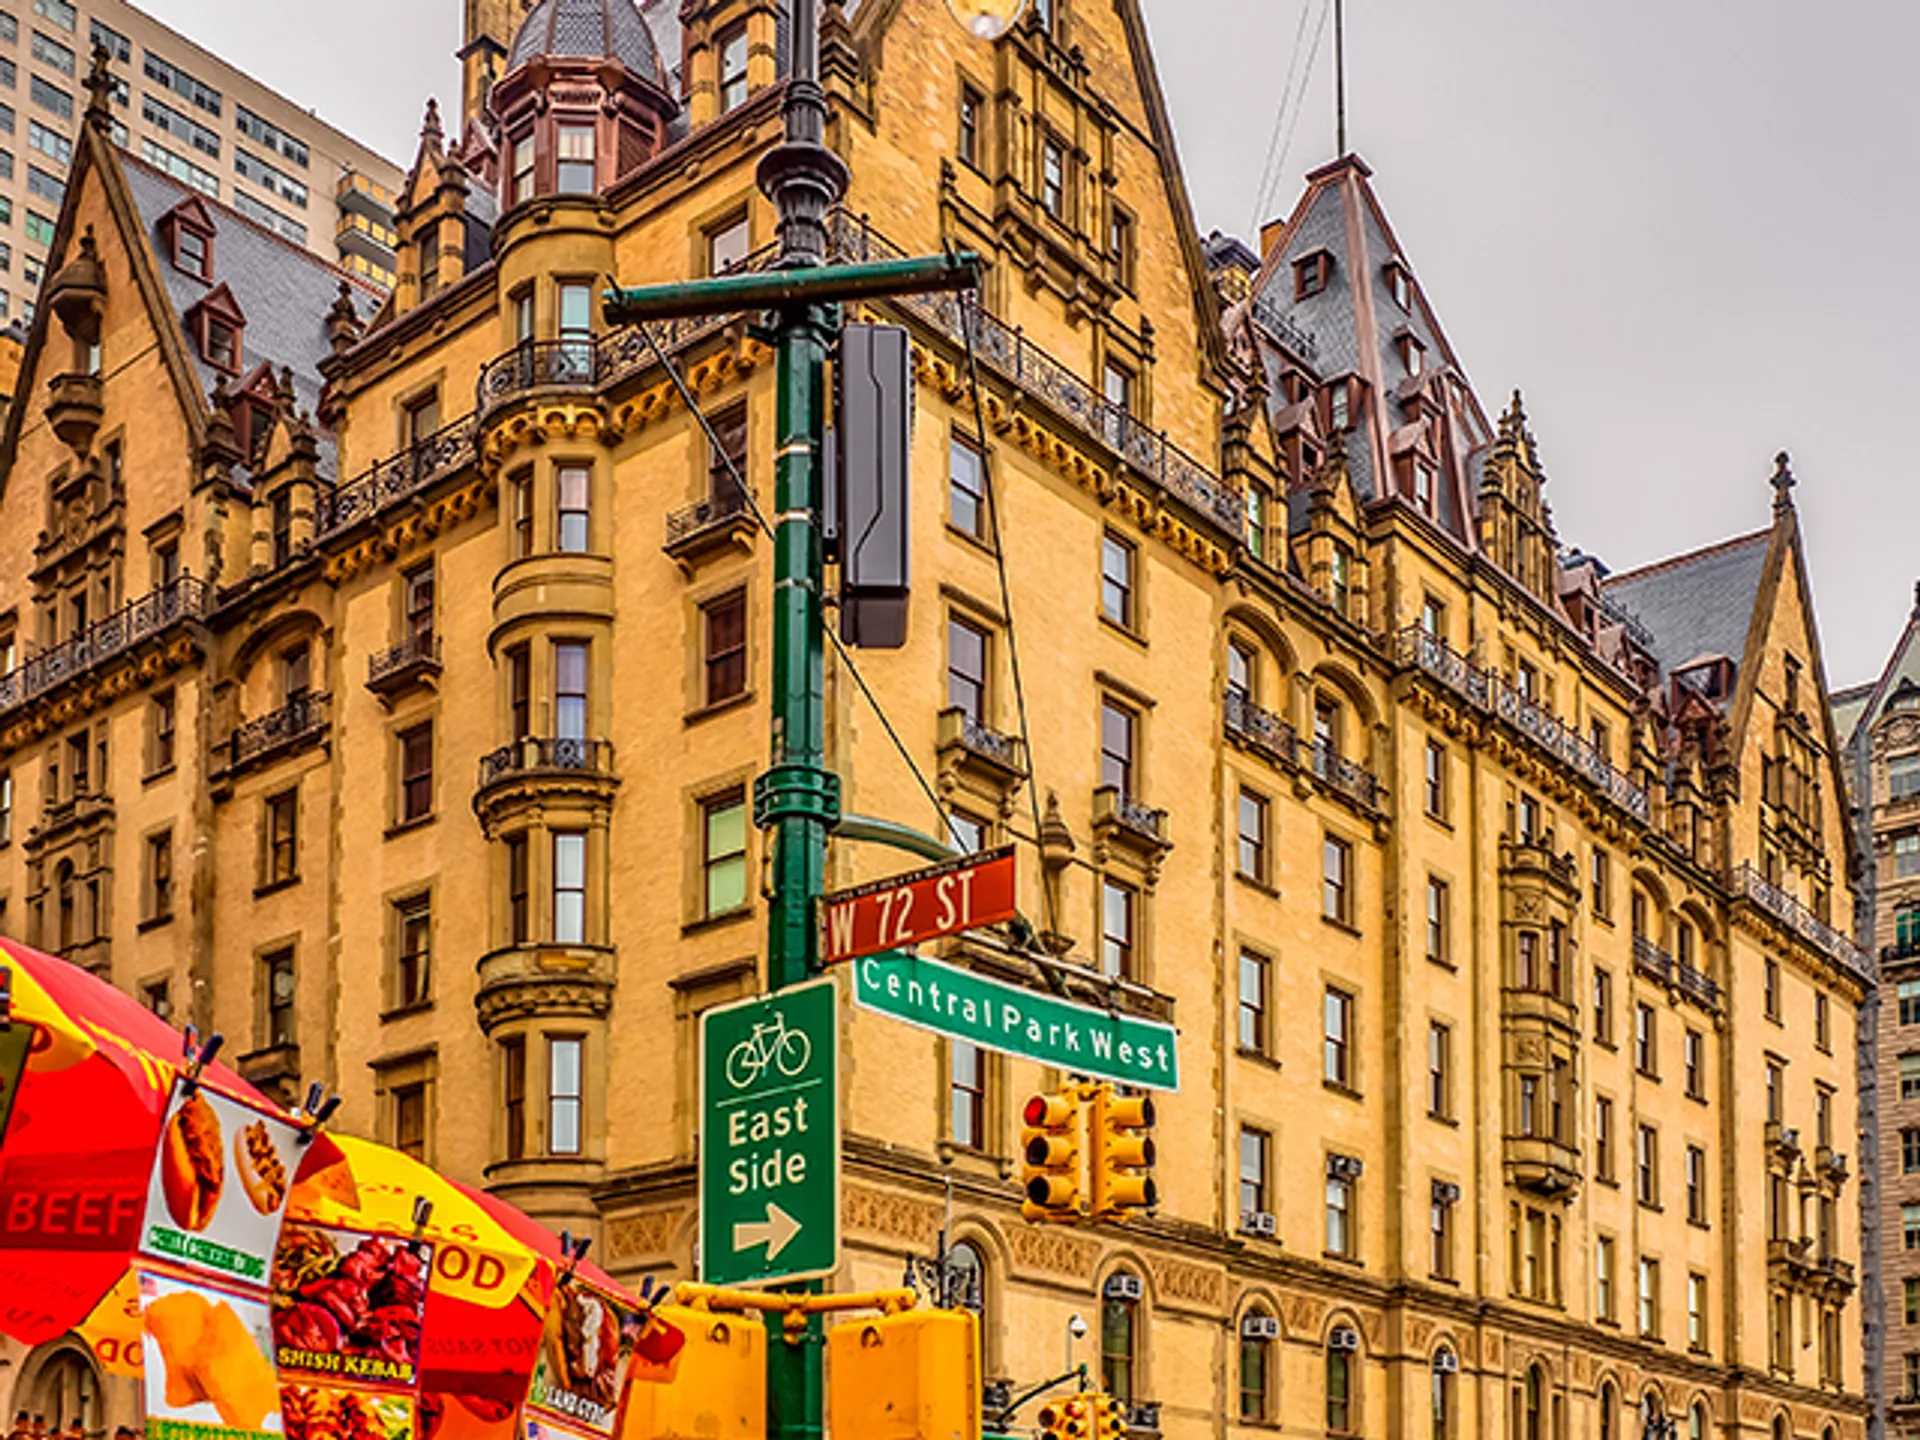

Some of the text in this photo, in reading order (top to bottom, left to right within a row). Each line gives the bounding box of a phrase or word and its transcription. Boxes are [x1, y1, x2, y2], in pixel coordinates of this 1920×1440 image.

[830, 901, 856, 956] W
[875, 887, 914, 946] 72
[936, 869, 976, 931] ST
[861, 957, 1169, 1073] Central Park West
[728, 1096, 809, 1147] East
[728, 1148, 807, 1195] Side
[4, 1191, 142, 1236] BEEF
[278, 1347, 413, 1380] SHISH KEBAB
